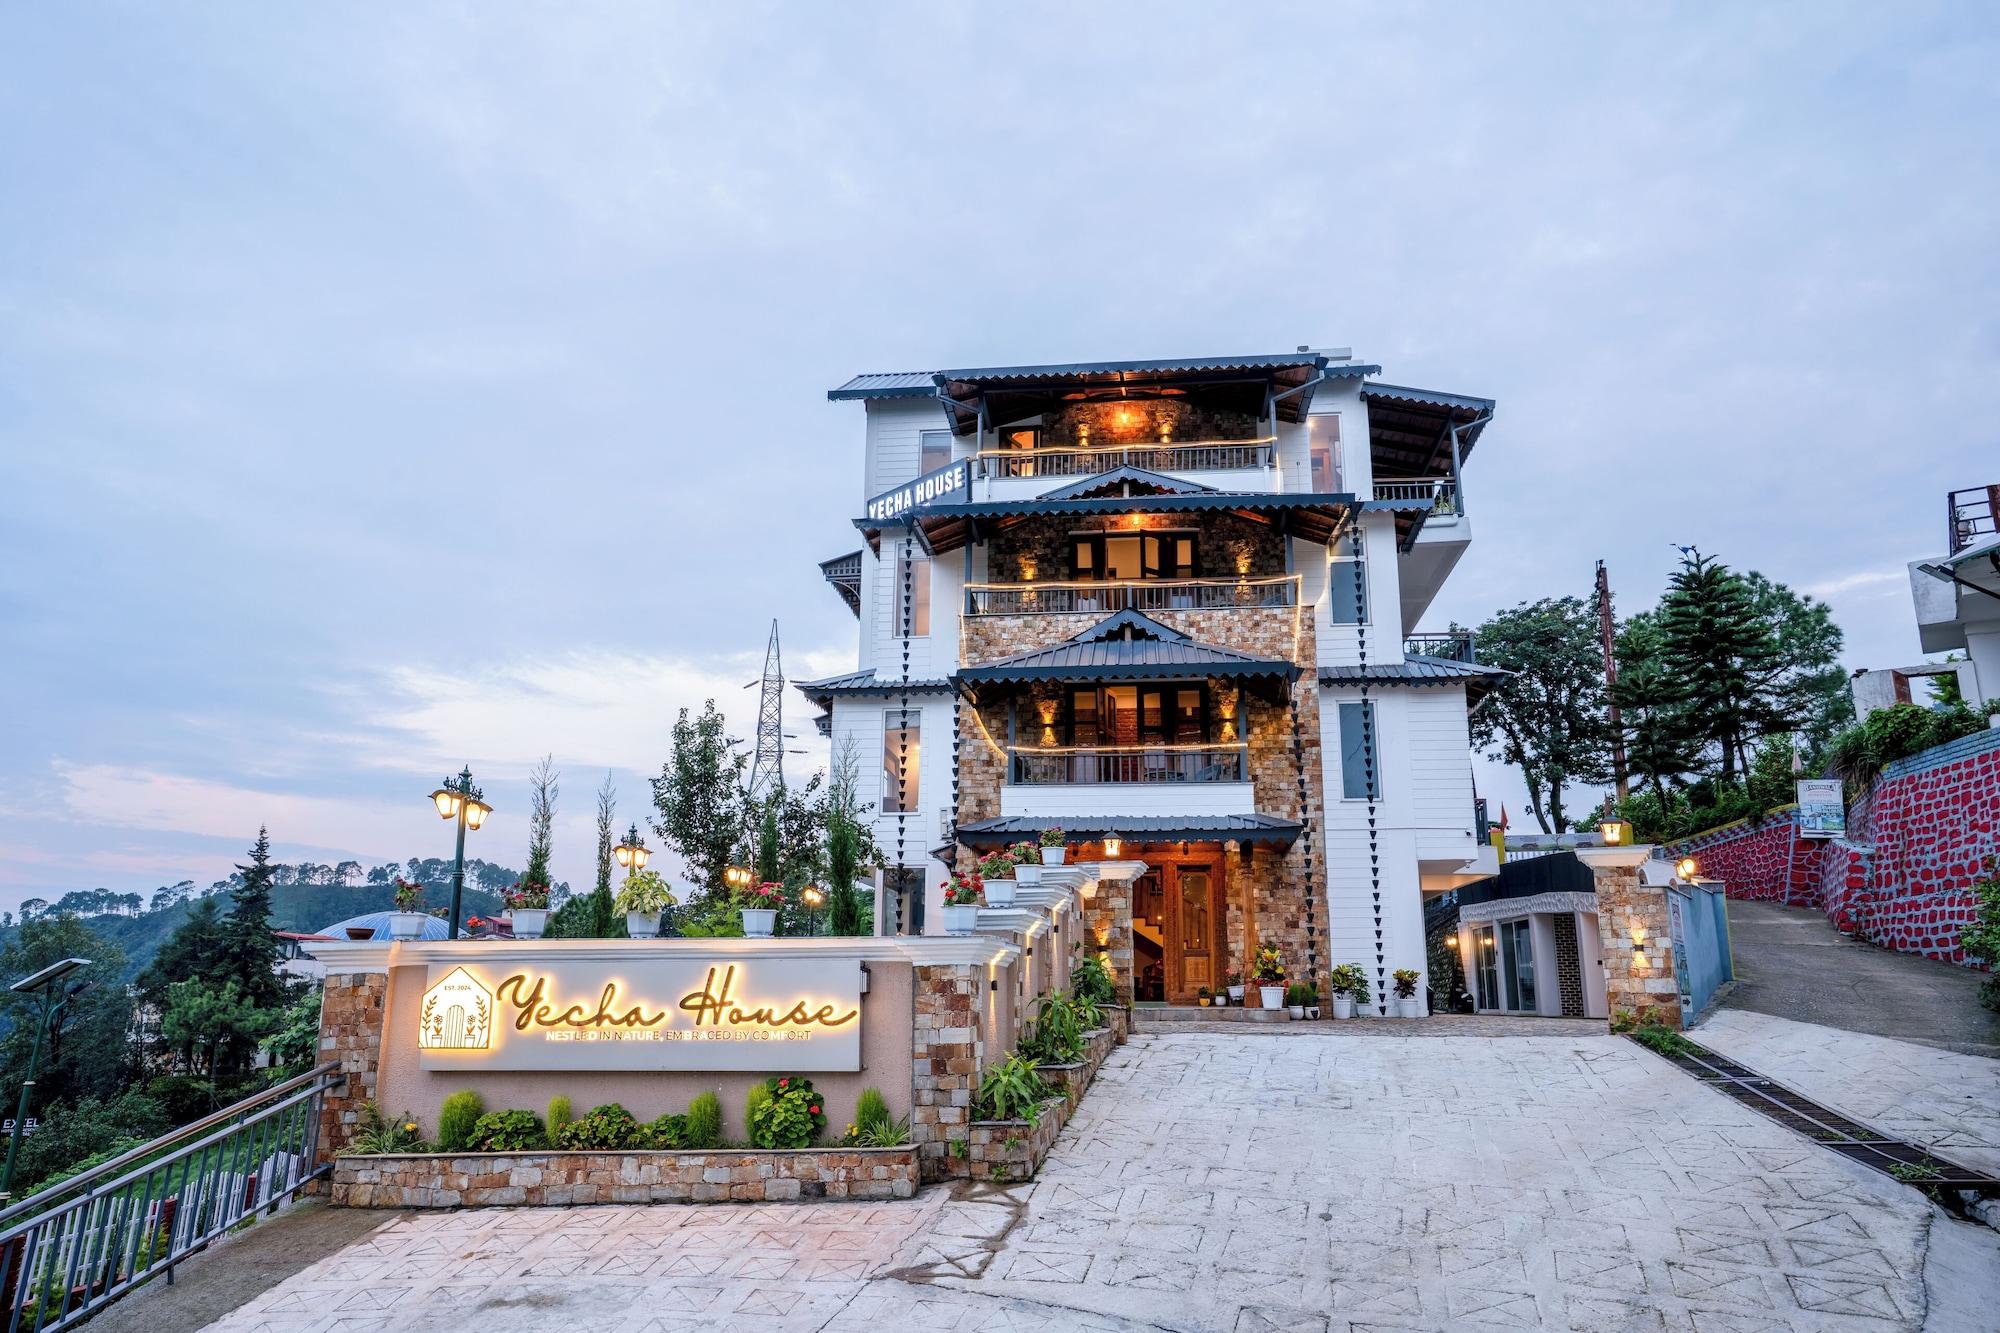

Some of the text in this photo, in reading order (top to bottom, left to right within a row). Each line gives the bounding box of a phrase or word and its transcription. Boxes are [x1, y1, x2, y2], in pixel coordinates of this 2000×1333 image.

[869, 466, 963, 519] YECHA HOUSE
[496, 965, 858, 1030] Yecha House
[545, 1030, 812, 1042] NESTLED IN NATURE, EMBRACED BY COMFORT
[3, 1118, 39, 1128] EXEL
